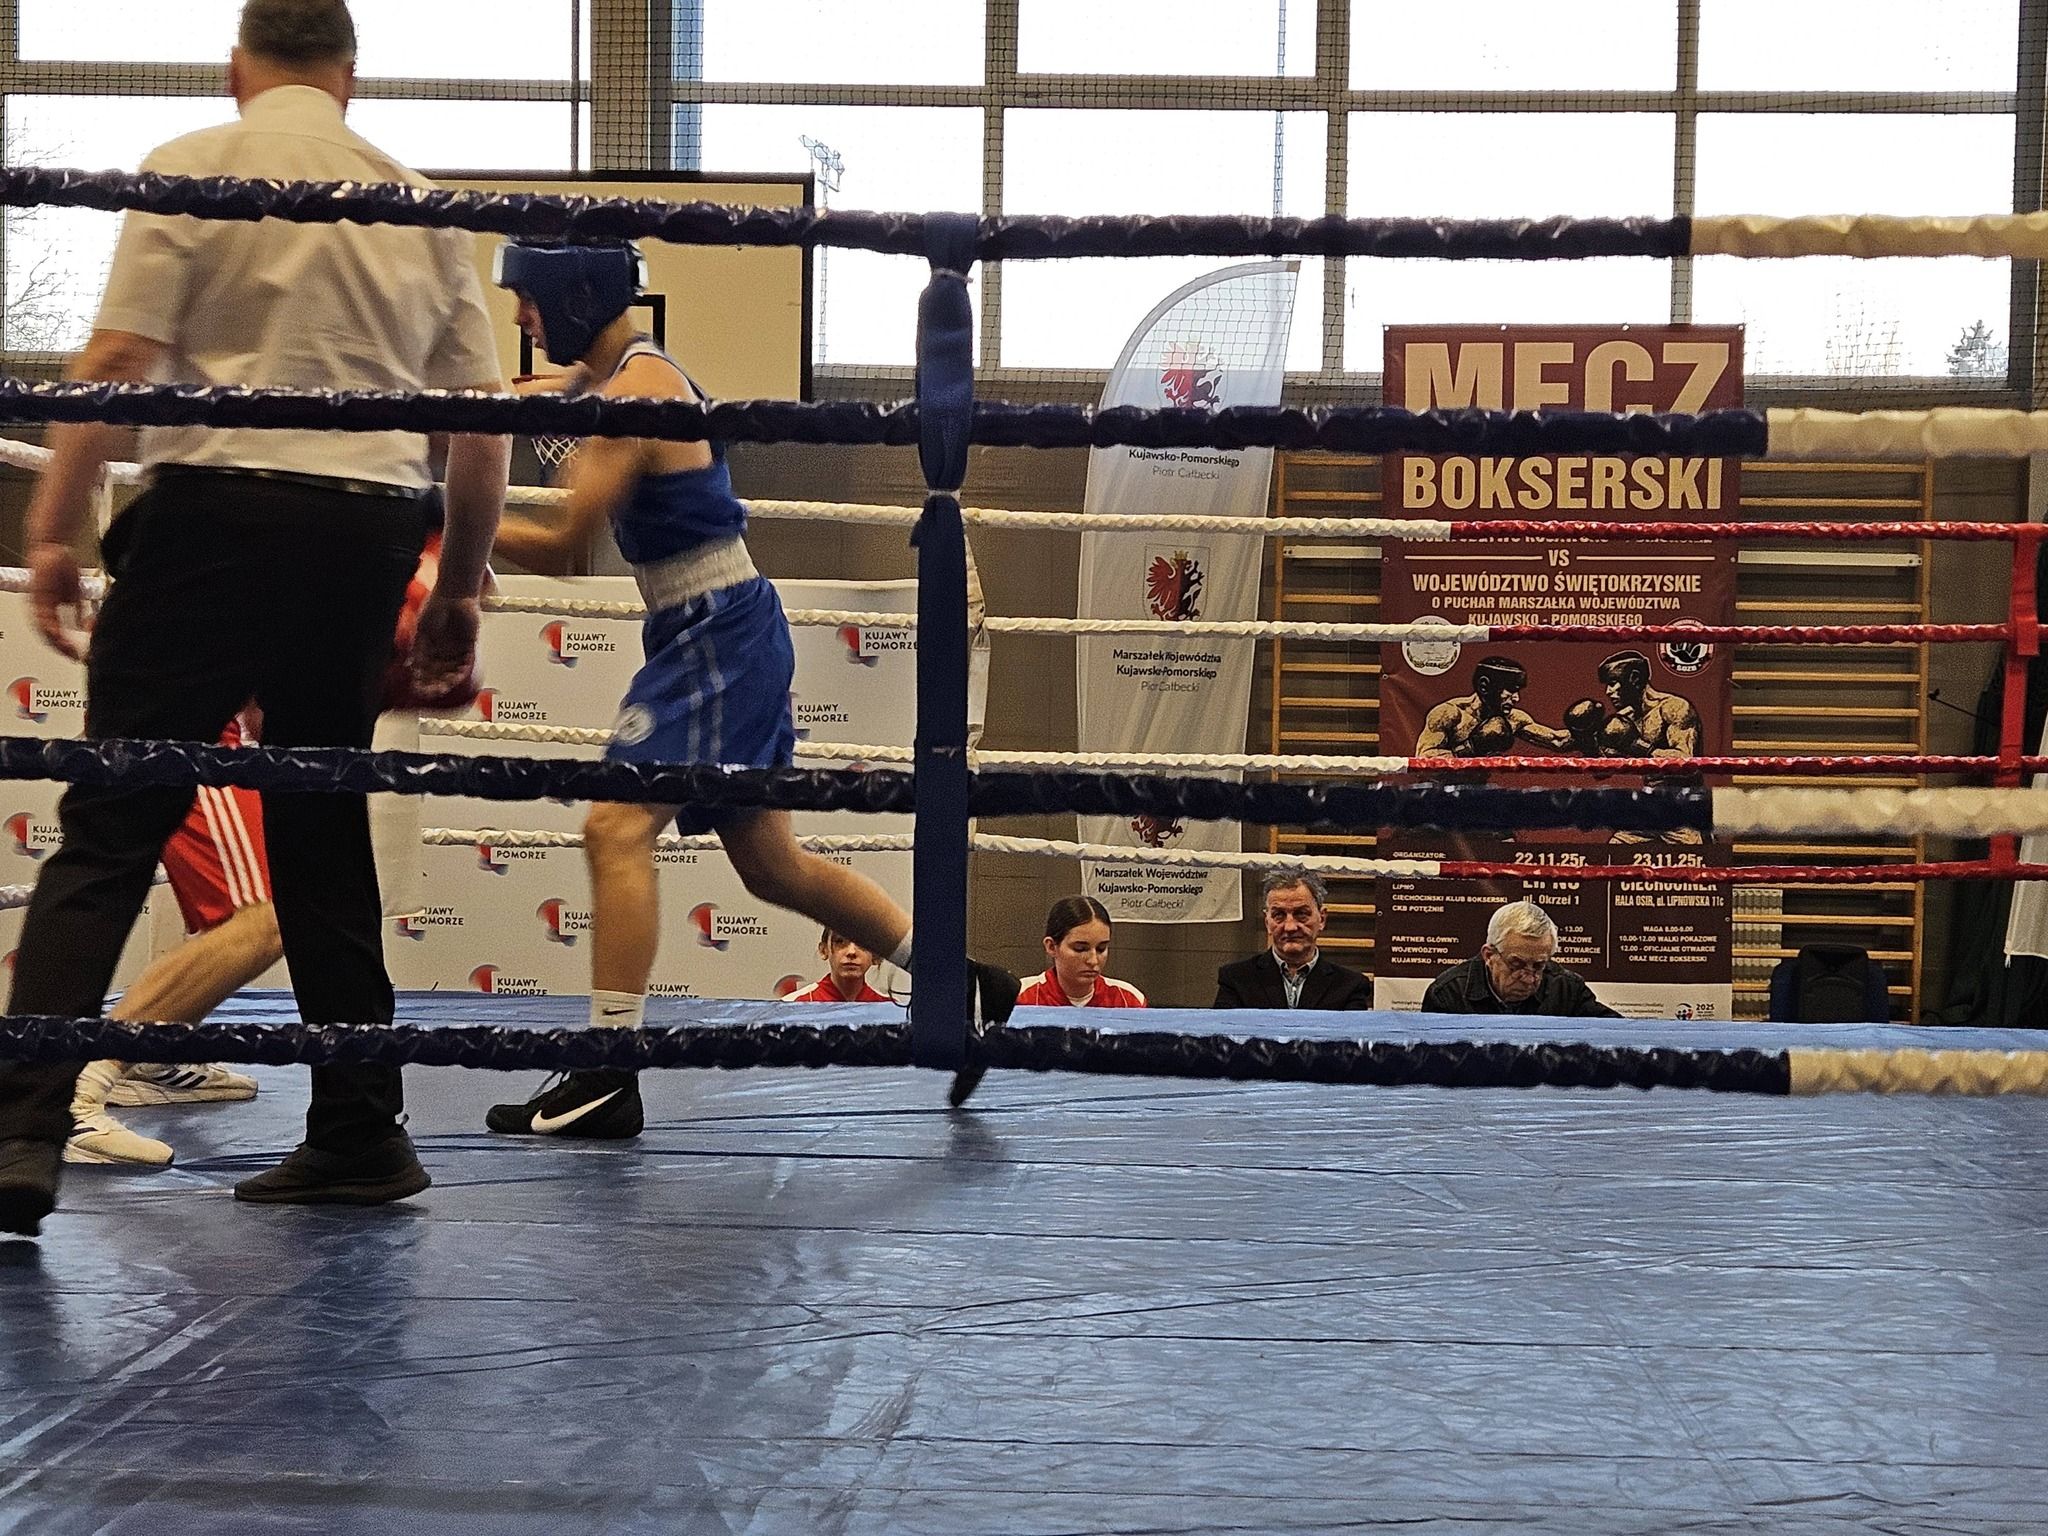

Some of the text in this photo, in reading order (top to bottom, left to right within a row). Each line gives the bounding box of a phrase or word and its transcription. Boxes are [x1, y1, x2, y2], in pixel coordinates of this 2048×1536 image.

[1402, 456, 1723, 511] BOKSERSKI
[1548, 549, 1570, 567] VS
[1412, 571, 1702, 595] WOJEWÓDZTWO ŚWIĘTOKRZYSKIE
[1431, 595, 1681, 609] O PUCHAR MARSZAŁKA WOJEWÓDZTWA
[1468, 613, 1539, 625] KUJAWSKO
[1550, 613, 1643, 626] POMORSKIEGO
[566, 633, 607, 641] KUJAWY
[865, 632, 909, 640] KUJAWY
[566, 643, 616, 651] POMORZE
[865, 641, 917, 650] POMORZE
[1112, 649, 1164, 661] Marszałek
[35, 690, 79, 698] KUJAWY
[497, 701, 538, 709] KUJAWY
[797, 704, 839, 712] KUJAWY
[497, 711, 547, 720] POMORZE
[797, 714, 849, 722] POMORZE
[33, 826, 63, 834] KUJA
[33, 835, 64, 844] POMO
[496, 851, 547, 860] POMORZE
[654, 855, 698, 864] OMORZE
[1095, 867, 1144, 878] Marszałek
[1098, 883, 1204, 896] Kujawsko-Pomorskiego
[1574, 895, 1580, 905] 1
[424, 907, 455, 915] JAWY
[564, 911, 594, 920] KUJA
[413, 917, 465, 926] POMORZE
[716, 916, 759, 925] KUJAWY
[564, 921, 594, 930] POMO
[716, 926, 768, 935] POMORZE
[1556, 936, 1593, 944] OKAZOWE
[497, 977, 538, 986] KUJAWY
[497, 987, 547, 996] POMORZE
[649, 984, 690, 992] KUJAWY
